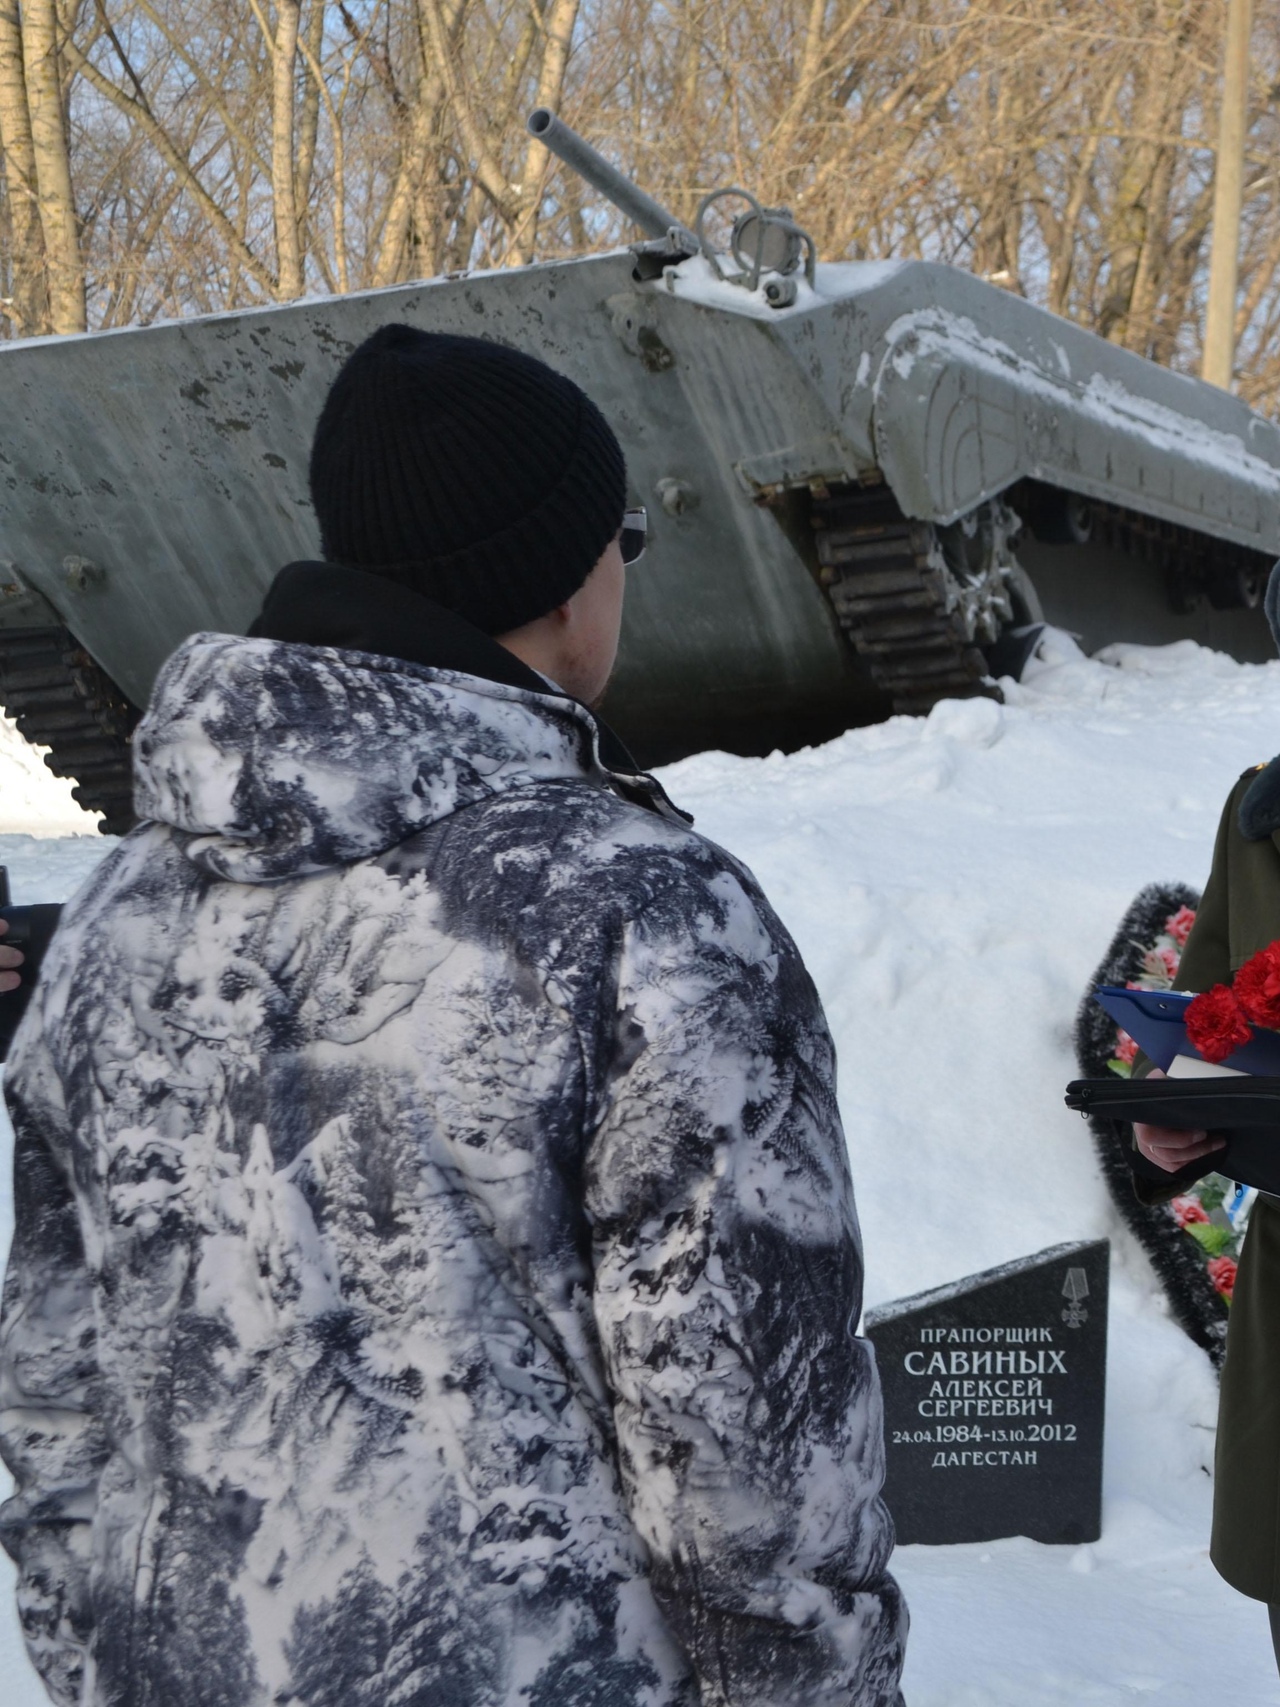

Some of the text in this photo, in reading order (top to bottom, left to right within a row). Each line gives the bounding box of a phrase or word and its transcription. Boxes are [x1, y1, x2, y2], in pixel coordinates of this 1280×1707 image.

[920, 1327, 1053, 1344] ПРАПОРЩИК
[903, 1350, 1067, 1375] САВИНЫХ
[929, 1377, 1042, 1397] АЛЕКСЕЙ
[917, 1399, 1053, 1417] СЕРГЕЕВИЧ
[931, 1451, 1038, 1467] ДАГЕСТАН
